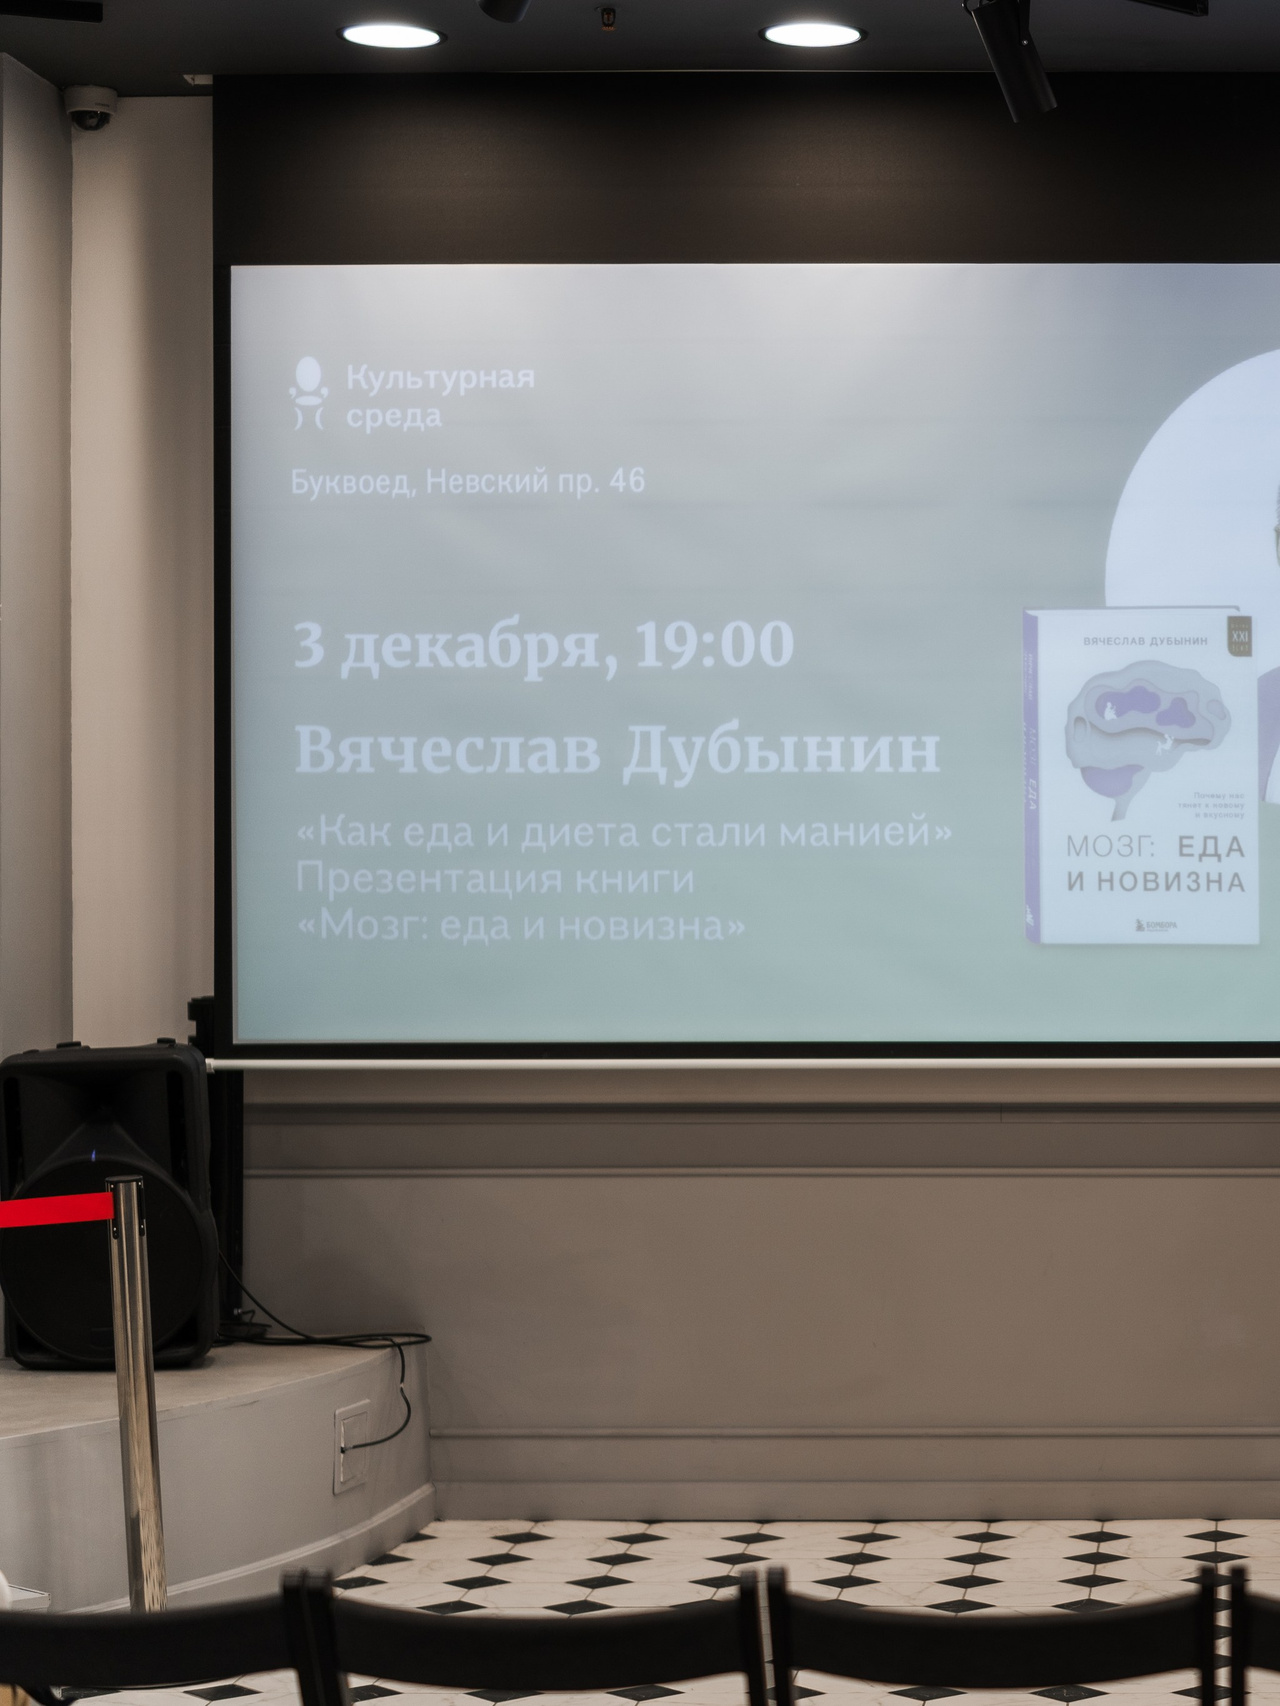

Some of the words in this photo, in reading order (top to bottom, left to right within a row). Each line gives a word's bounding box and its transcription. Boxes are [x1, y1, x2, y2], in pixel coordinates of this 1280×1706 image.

[346, 364, 536, 396] Культурная
[346, 407, 443, 434] среда
[291, 468, 417, 501] Буквоед,
[427, 466, 549, 494] Невский
[558, 474, 599, 499] пр.
[609, 466, 646, 493] 46
[294, 621, 325, 669] 3
[340, 613, 618, 682] декабря,
[636, 620, 795, 670] 19:00
[1083, 636, 1146, 646] ВЯЧЕСЛАВ
[1149, 636, 1208, 647] ДУБЫНИН
[295, 725, 601, 774] Вячеслав
[622, 718, 942, 788] Дубынин
[297, 816, 392, 846] «Как
[403, 823, 474, 853] еда
[486, 823, 510, 847] и
[520, 822, 640, 853] диета
[650, 822, 767, 847] стали
[779, 812, 953, 847] манией»
[1067, 835, 1155, 858] МОЗГ:
[1178, 836, 1246, 862] ЕДА
[297, 861, 564, 900] Презентация
[575, 866, 696, 894] книги
[1067, 872, 1085, 892] И
[1098, 872, 1246, 893] НОВИЗНА
[297, 907, 430, 941] «Мозг:
[440, 914, 511, 944] еда
[523, 915, 545, 940] и
[558, 914, 746, 941] новизна»
